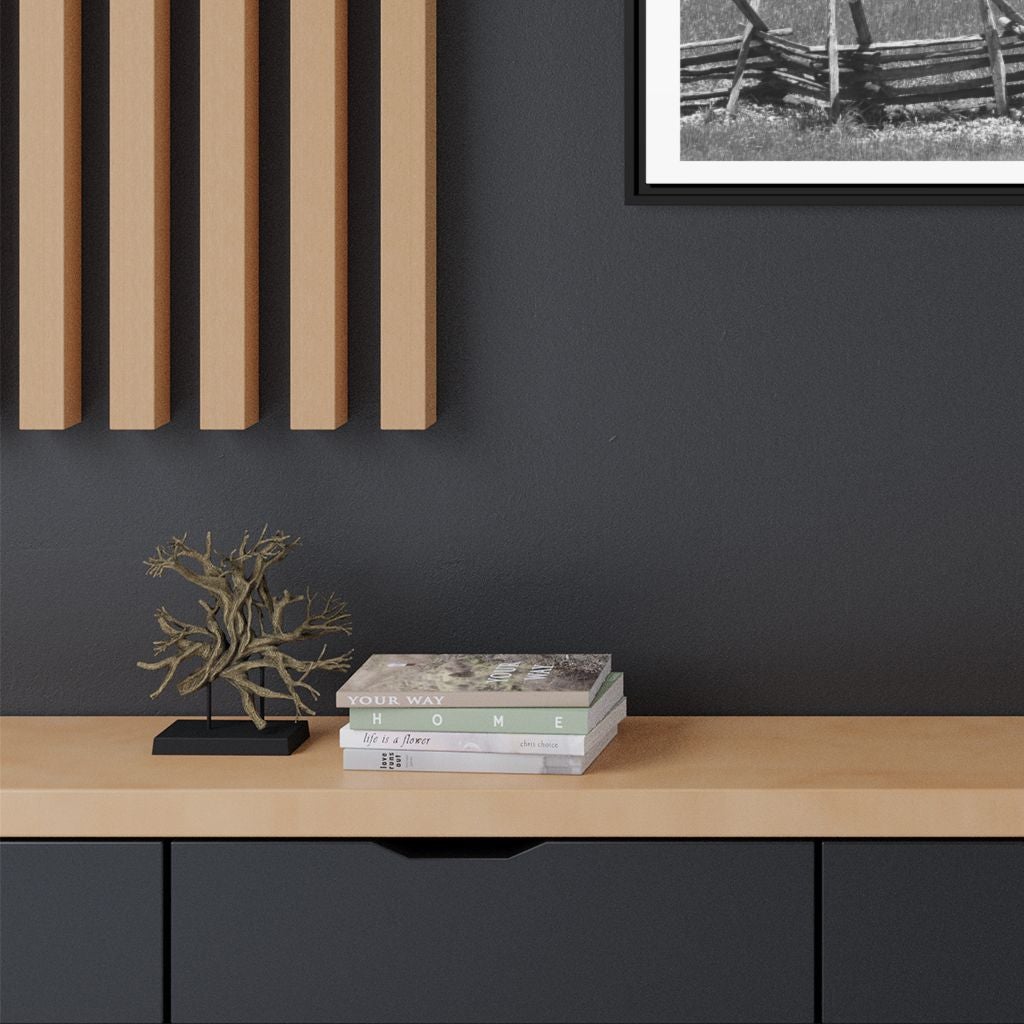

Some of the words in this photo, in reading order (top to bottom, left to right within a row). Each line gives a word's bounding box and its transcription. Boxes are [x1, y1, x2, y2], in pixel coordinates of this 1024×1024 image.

[487, 661, 521, 683] YOUR
[523, 664, 554, 681] WAY
[348, 695, 399, 705] YOUR
[407, 695, 446, 705] WAY
[372, 713, 563, 728] HOME
[363, 732, 378, 747] life
[382, 734, 389, 744] is
[393, 736, 399, 744] a
[400, 734, 431, 747] flower
[520, 739, 535, 748] chris
[537, 740, 558, 749] choice
[380, 752, 388, 769] love
